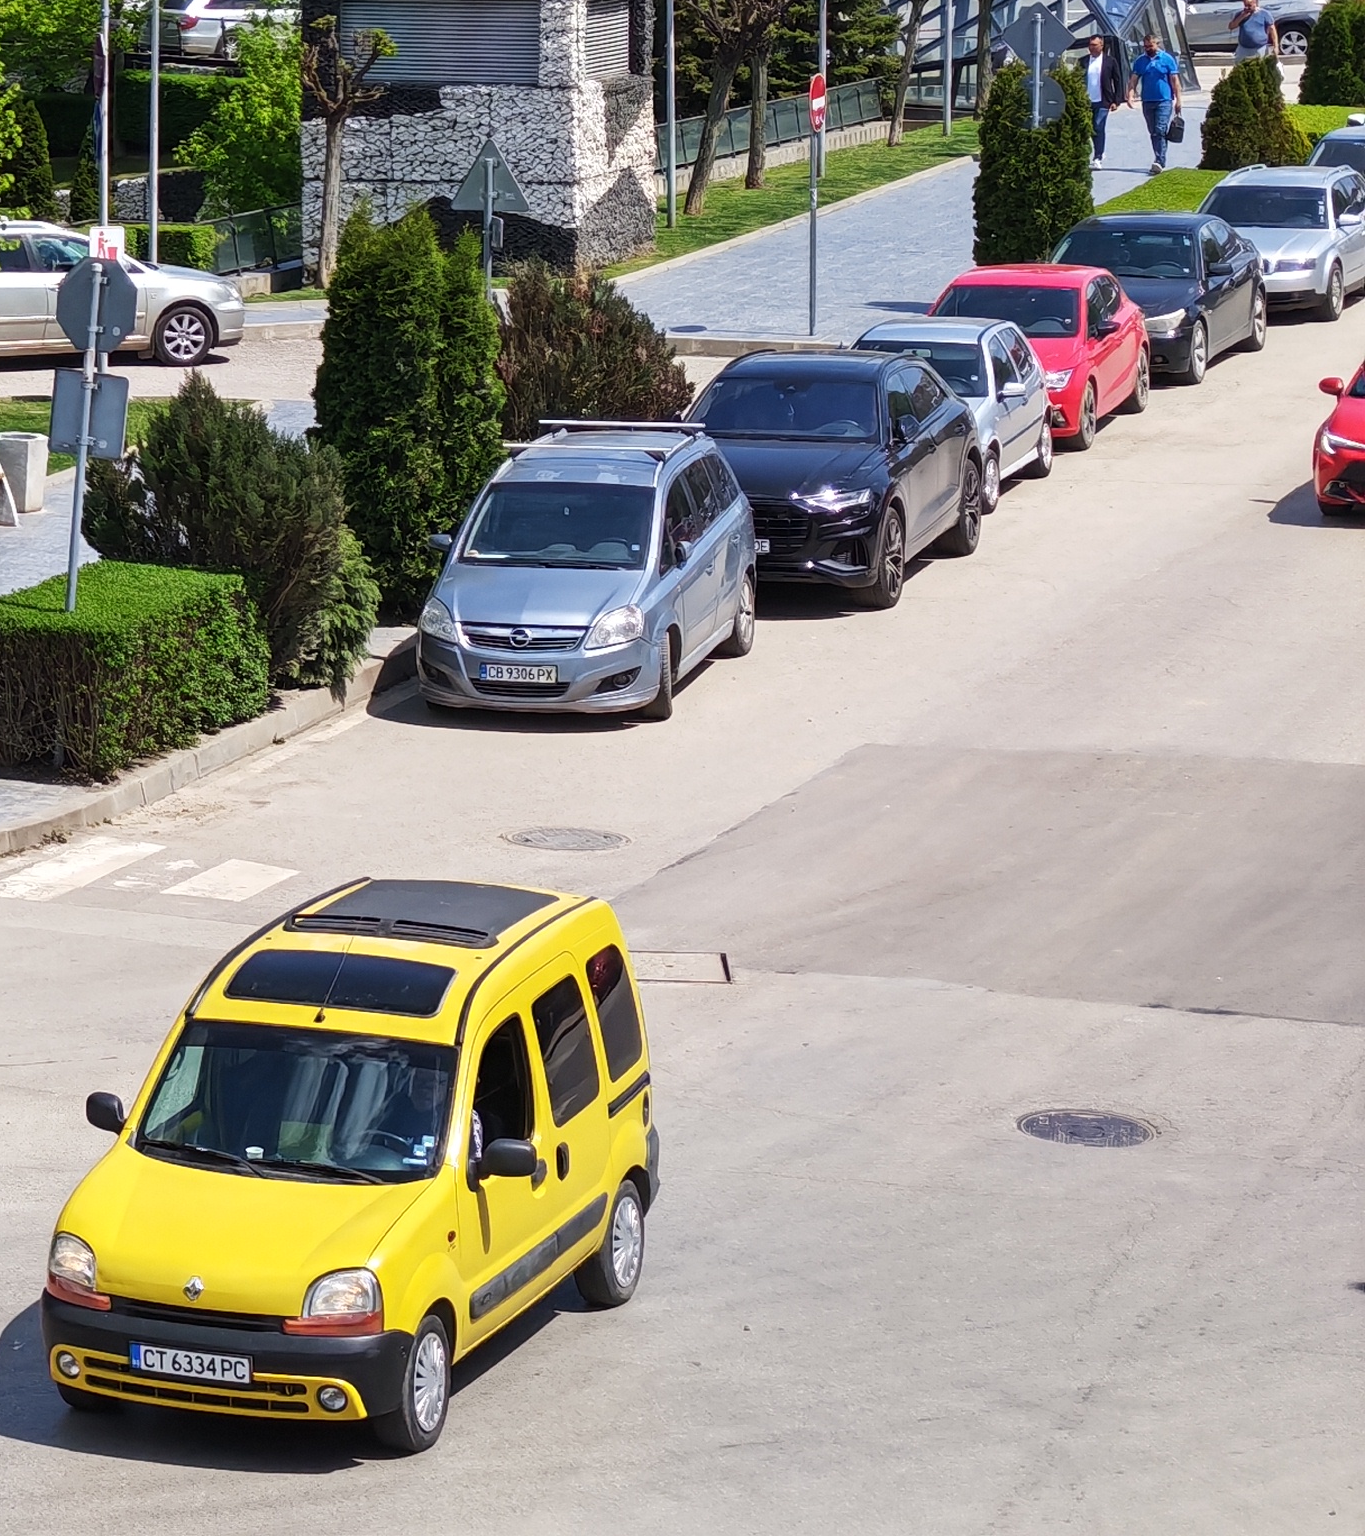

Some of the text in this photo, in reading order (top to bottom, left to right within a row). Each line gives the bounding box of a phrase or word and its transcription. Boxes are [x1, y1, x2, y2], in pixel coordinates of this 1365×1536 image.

[488, 666, 503, 679] CB
[506, 667, 535, 680] 9306
[537, 668, 553, 681] PX
[143, 1349, 167, 1370] CT
[171, 1352, 217, 1376] 6334
[220, 1358, 246, 1380] PC
